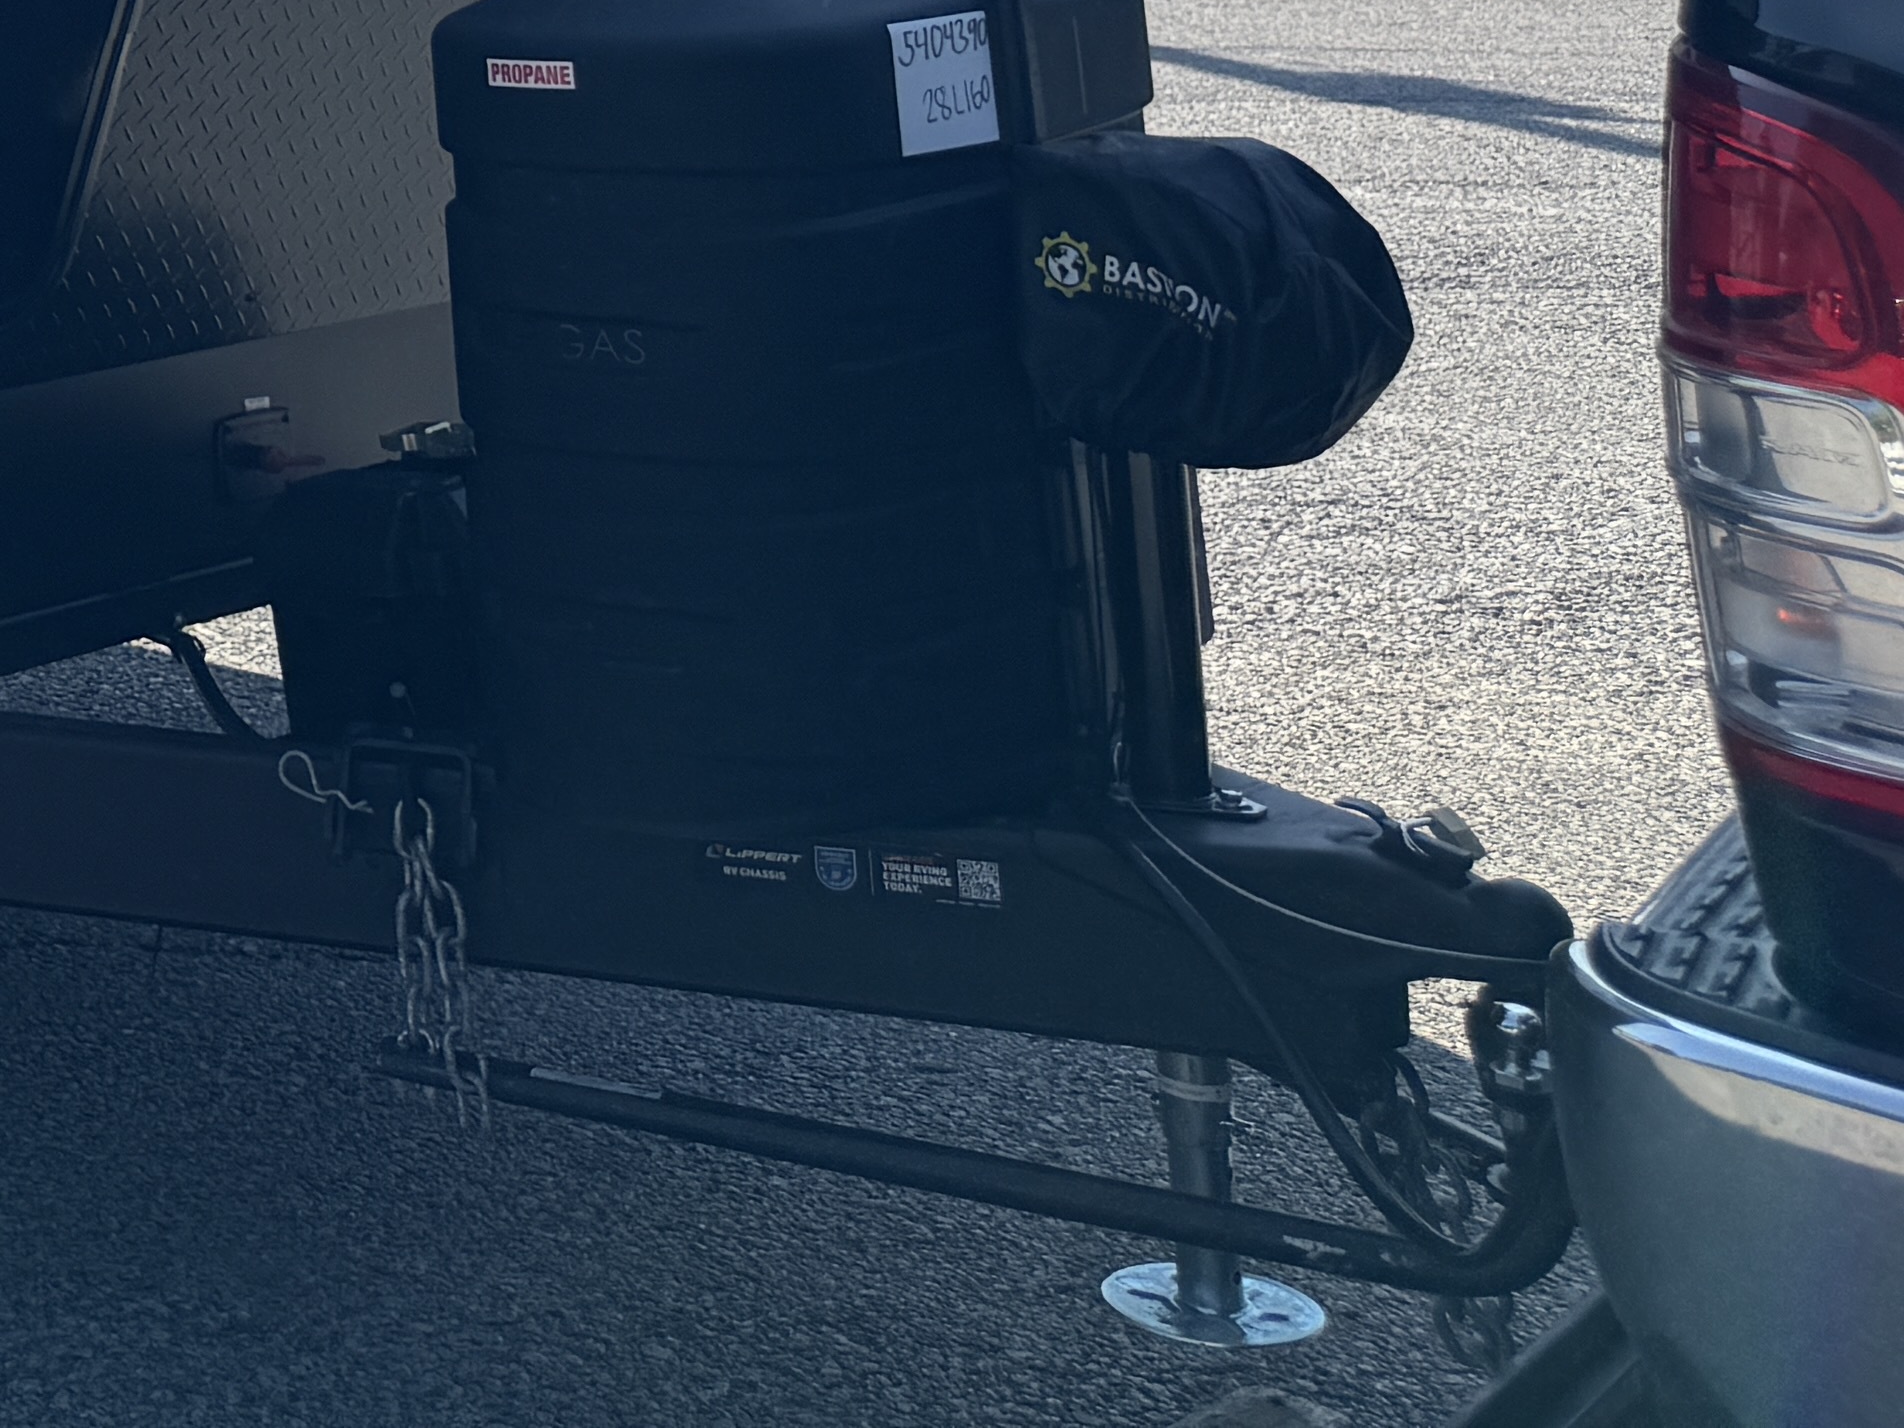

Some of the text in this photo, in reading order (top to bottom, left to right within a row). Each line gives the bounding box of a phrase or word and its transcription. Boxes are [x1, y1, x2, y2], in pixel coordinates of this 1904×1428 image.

[898, 17, 988, 67] 5404390
[491, 62, 572, 85] PROPANE
[882, 861, 911, 873] YOUR
[883, 871, 952, 887] EXPERIENCE
